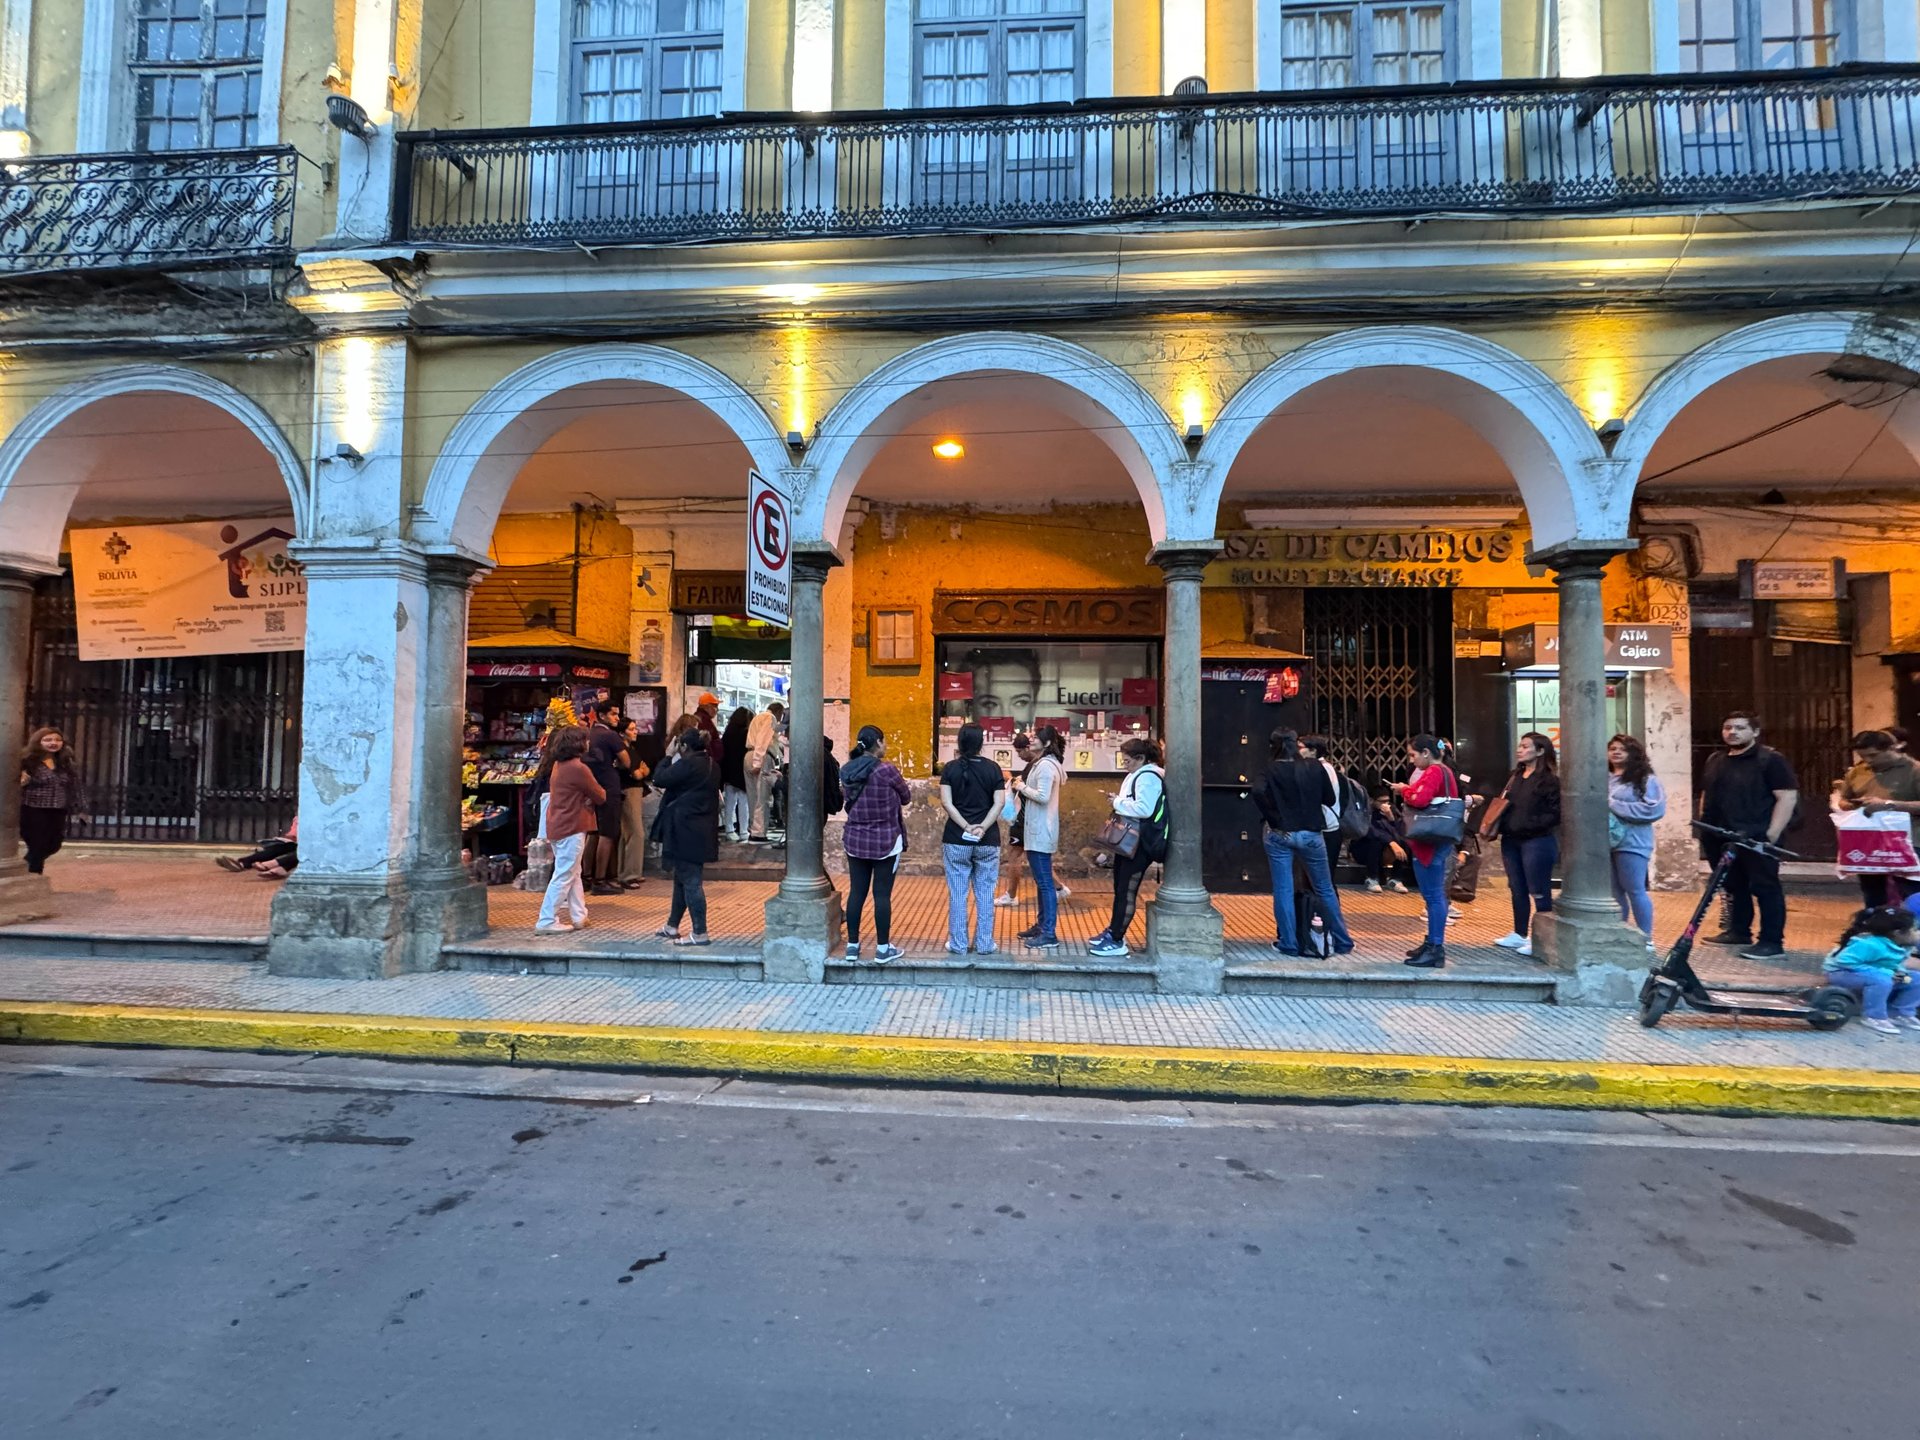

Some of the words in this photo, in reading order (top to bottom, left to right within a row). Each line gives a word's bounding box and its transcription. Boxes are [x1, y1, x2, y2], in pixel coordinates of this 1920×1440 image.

[1286, 533, 1332, 560] DE
[1346, 531, 1514, 561] CAMBIOS
[98, 570, 138, 581] BOLIVIA
[754, 571, 787, 596] PROHIBIDO
[1327, 567, 1464, 585] EXCHANGE
[260, 581, 306, 597] SIJPL
[687, 585, 743, 605] FARM
[751, 591, 789, 616] ESTACIONAR
[944, 600, 1154, 627] COSMOS
[1651, 605, 1688, 620] 0238
[1620, 630, 1648, 642] ATM
[1620, 645, 1661, 660] Cajero
[489, 664, 532, 677] Coca-Cola
